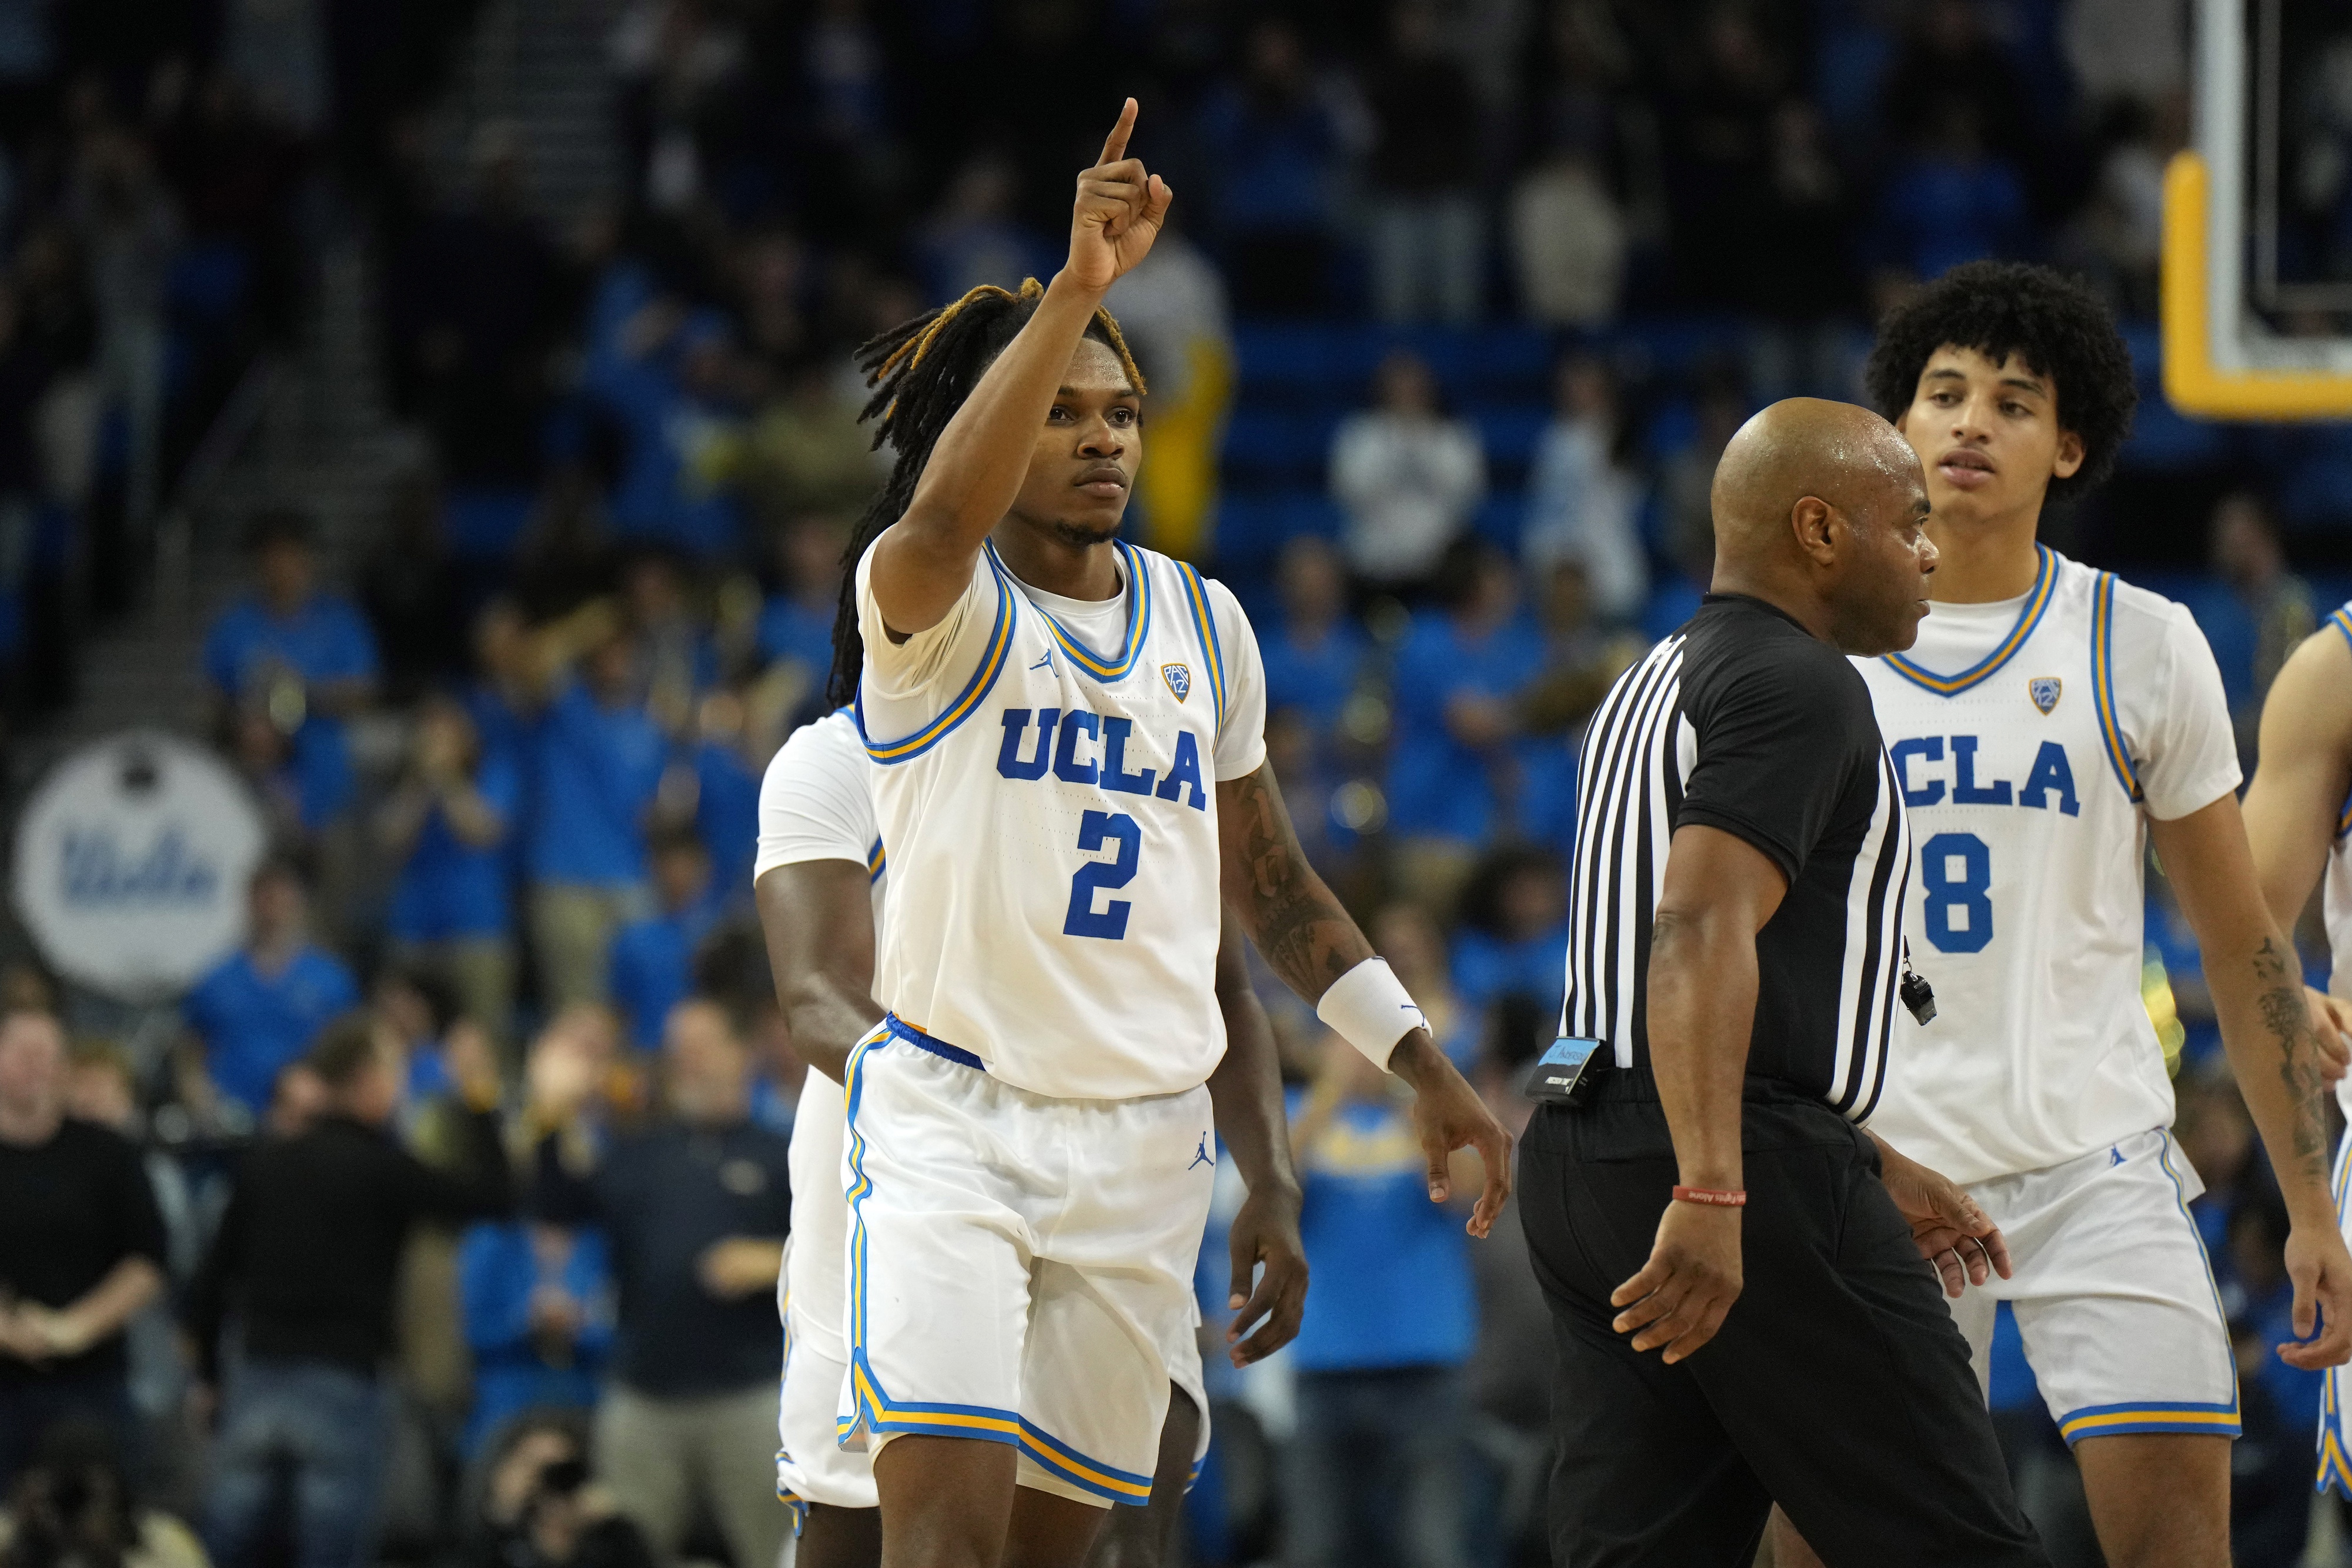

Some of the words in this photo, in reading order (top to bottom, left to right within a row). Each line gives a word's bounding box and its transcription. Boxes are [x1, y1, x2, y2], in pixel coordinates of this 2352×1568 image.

[1163, 665, 1189, 686] PAC
[1172, 679, 1187, 693] 12
[996, 708, 1206, 812] UCLA
[1889, 735, 2080, 818] CLA
[1063, 809, 1142, 940] 2
[1921, 833, 1994, 953] 8
